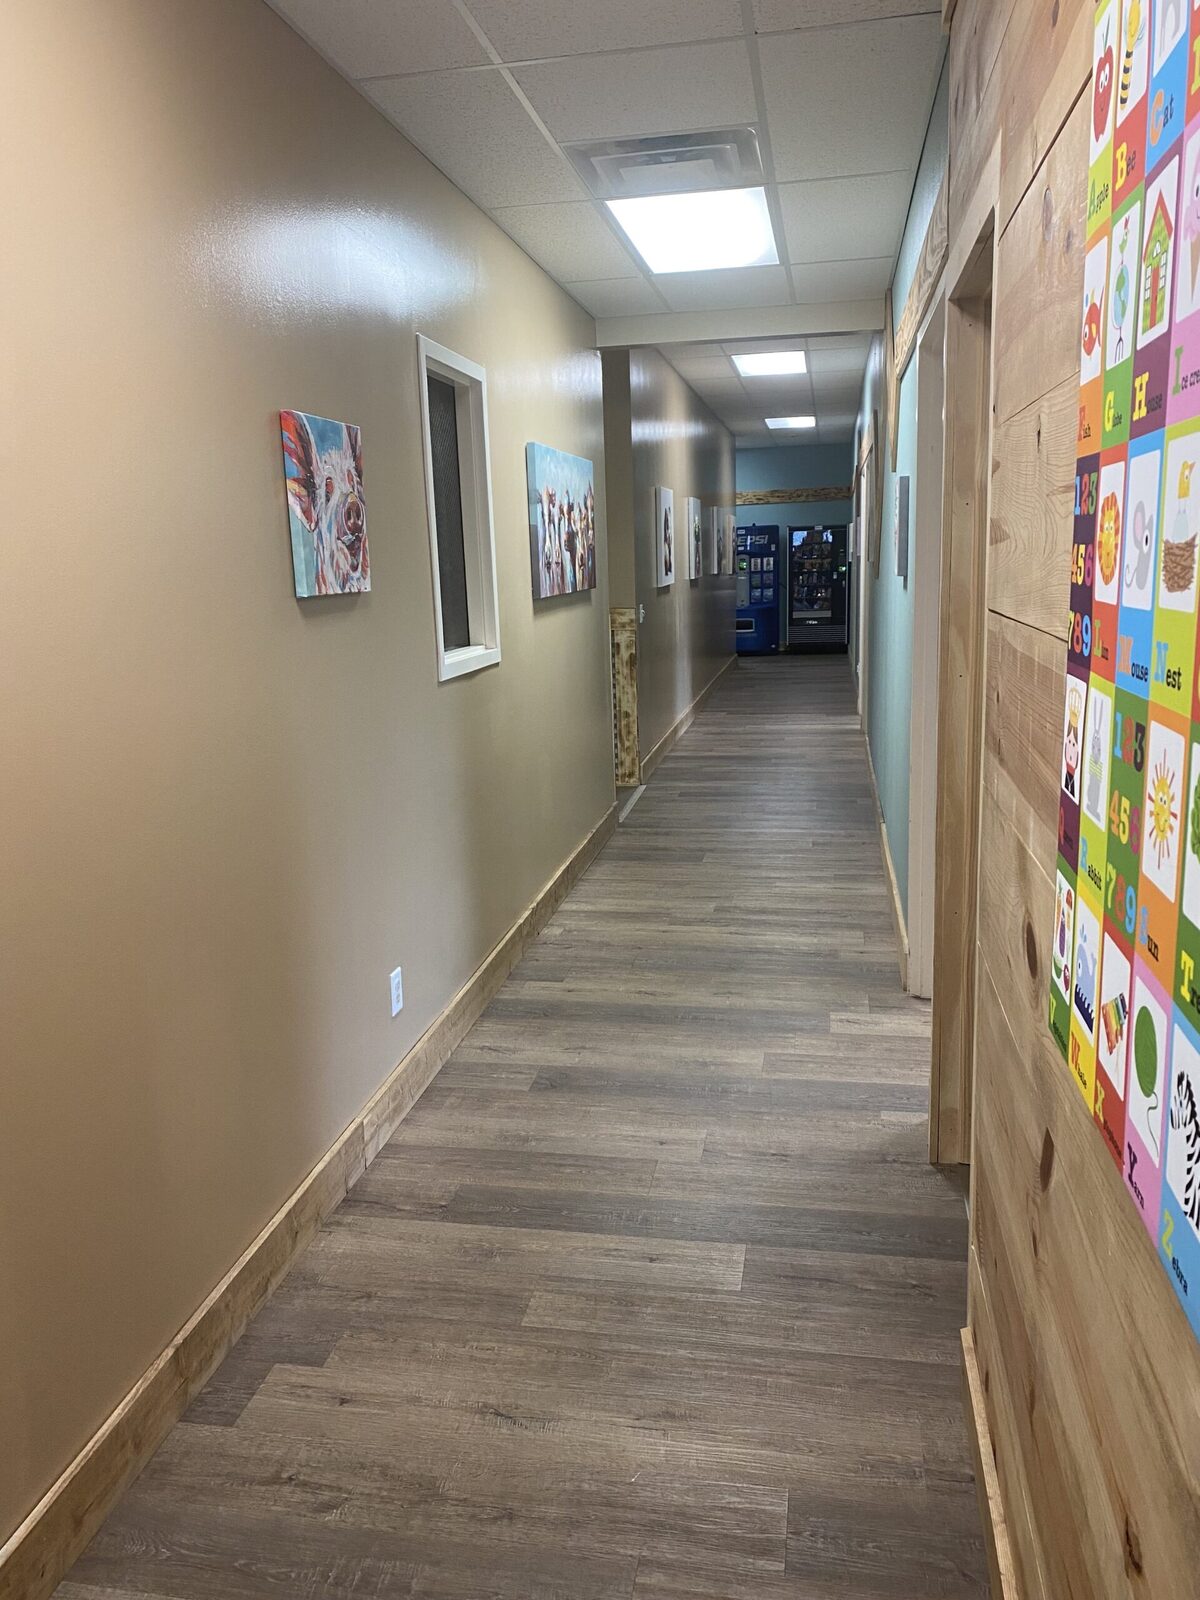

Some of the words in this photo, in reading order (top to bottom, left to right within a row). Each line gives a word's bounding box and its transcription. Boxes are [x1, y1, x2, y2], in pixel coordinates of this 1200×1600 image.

[1150, 90, 1174, 147] Cat
[1115, 141, 1136, 192] Bee
[1087, 178, 1109, 221] Apple
[1172, 345, 1188, 394] Ice
[1189, 369, 1200, 387] cre
[1075, 471, 1098, 515] 123
[736, 534, 769, 545] EPSI
[1071, 543, 1094, 586] 456
[1068, 610, 1092, 657] 789
[1117, 633, 1149, 683] Mouse
[1153, 640, 1182, 691] Nest
[1114, 711, 1146, 772] 123
[1109, 790, 1140, 855] 456
[1081, 835, 1102, 891] Rabbit
[1106, 861, 1137, 935] 789
[1139, 905, 1160, 962] Sun
[1180, 949, 1200, 1015] Tre
[1127, 1141, 1145, 1210] Yarn
[1161, 1208, 1188, 1296] Zebra
